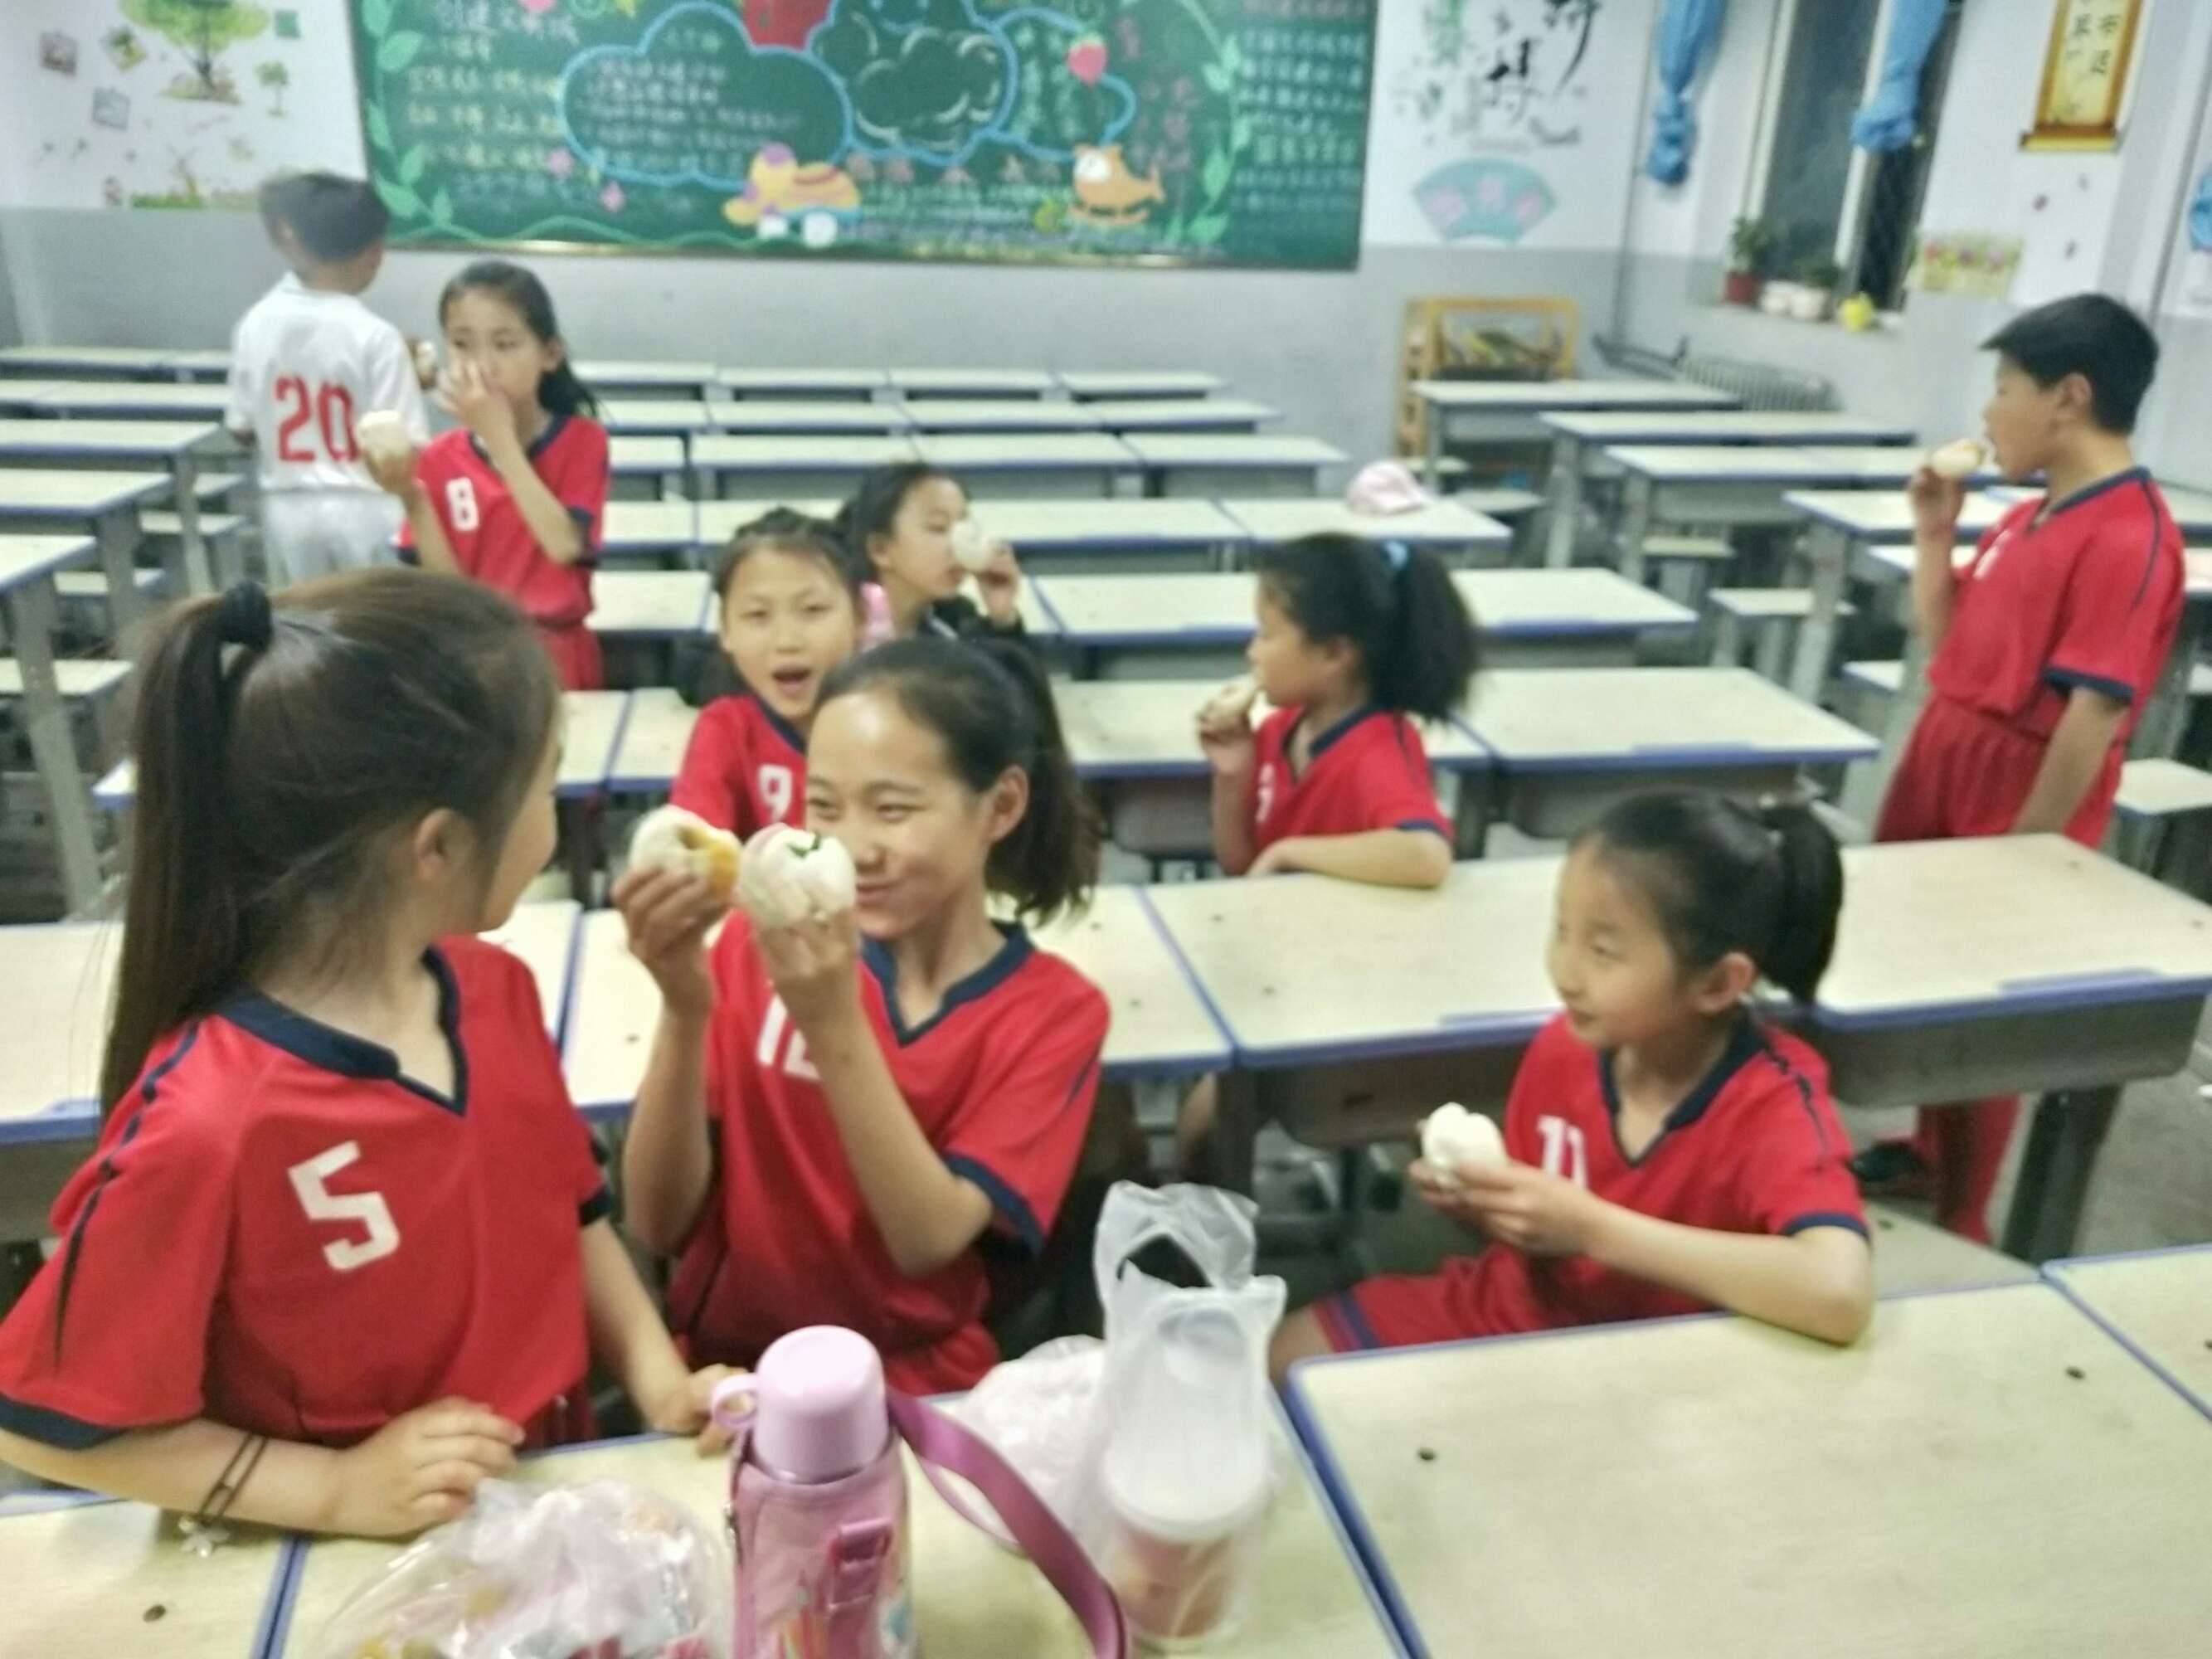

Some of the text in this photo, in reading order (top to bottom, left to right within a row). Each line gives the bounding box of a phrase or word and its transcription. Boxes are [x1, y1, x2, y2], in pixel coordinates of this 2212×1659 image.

[275, 376, 359, 463] 20
[445, 476, 479, 532] 8
[758, 762, 793, 823] 9
[287, 1139, 401, 1272] 5
